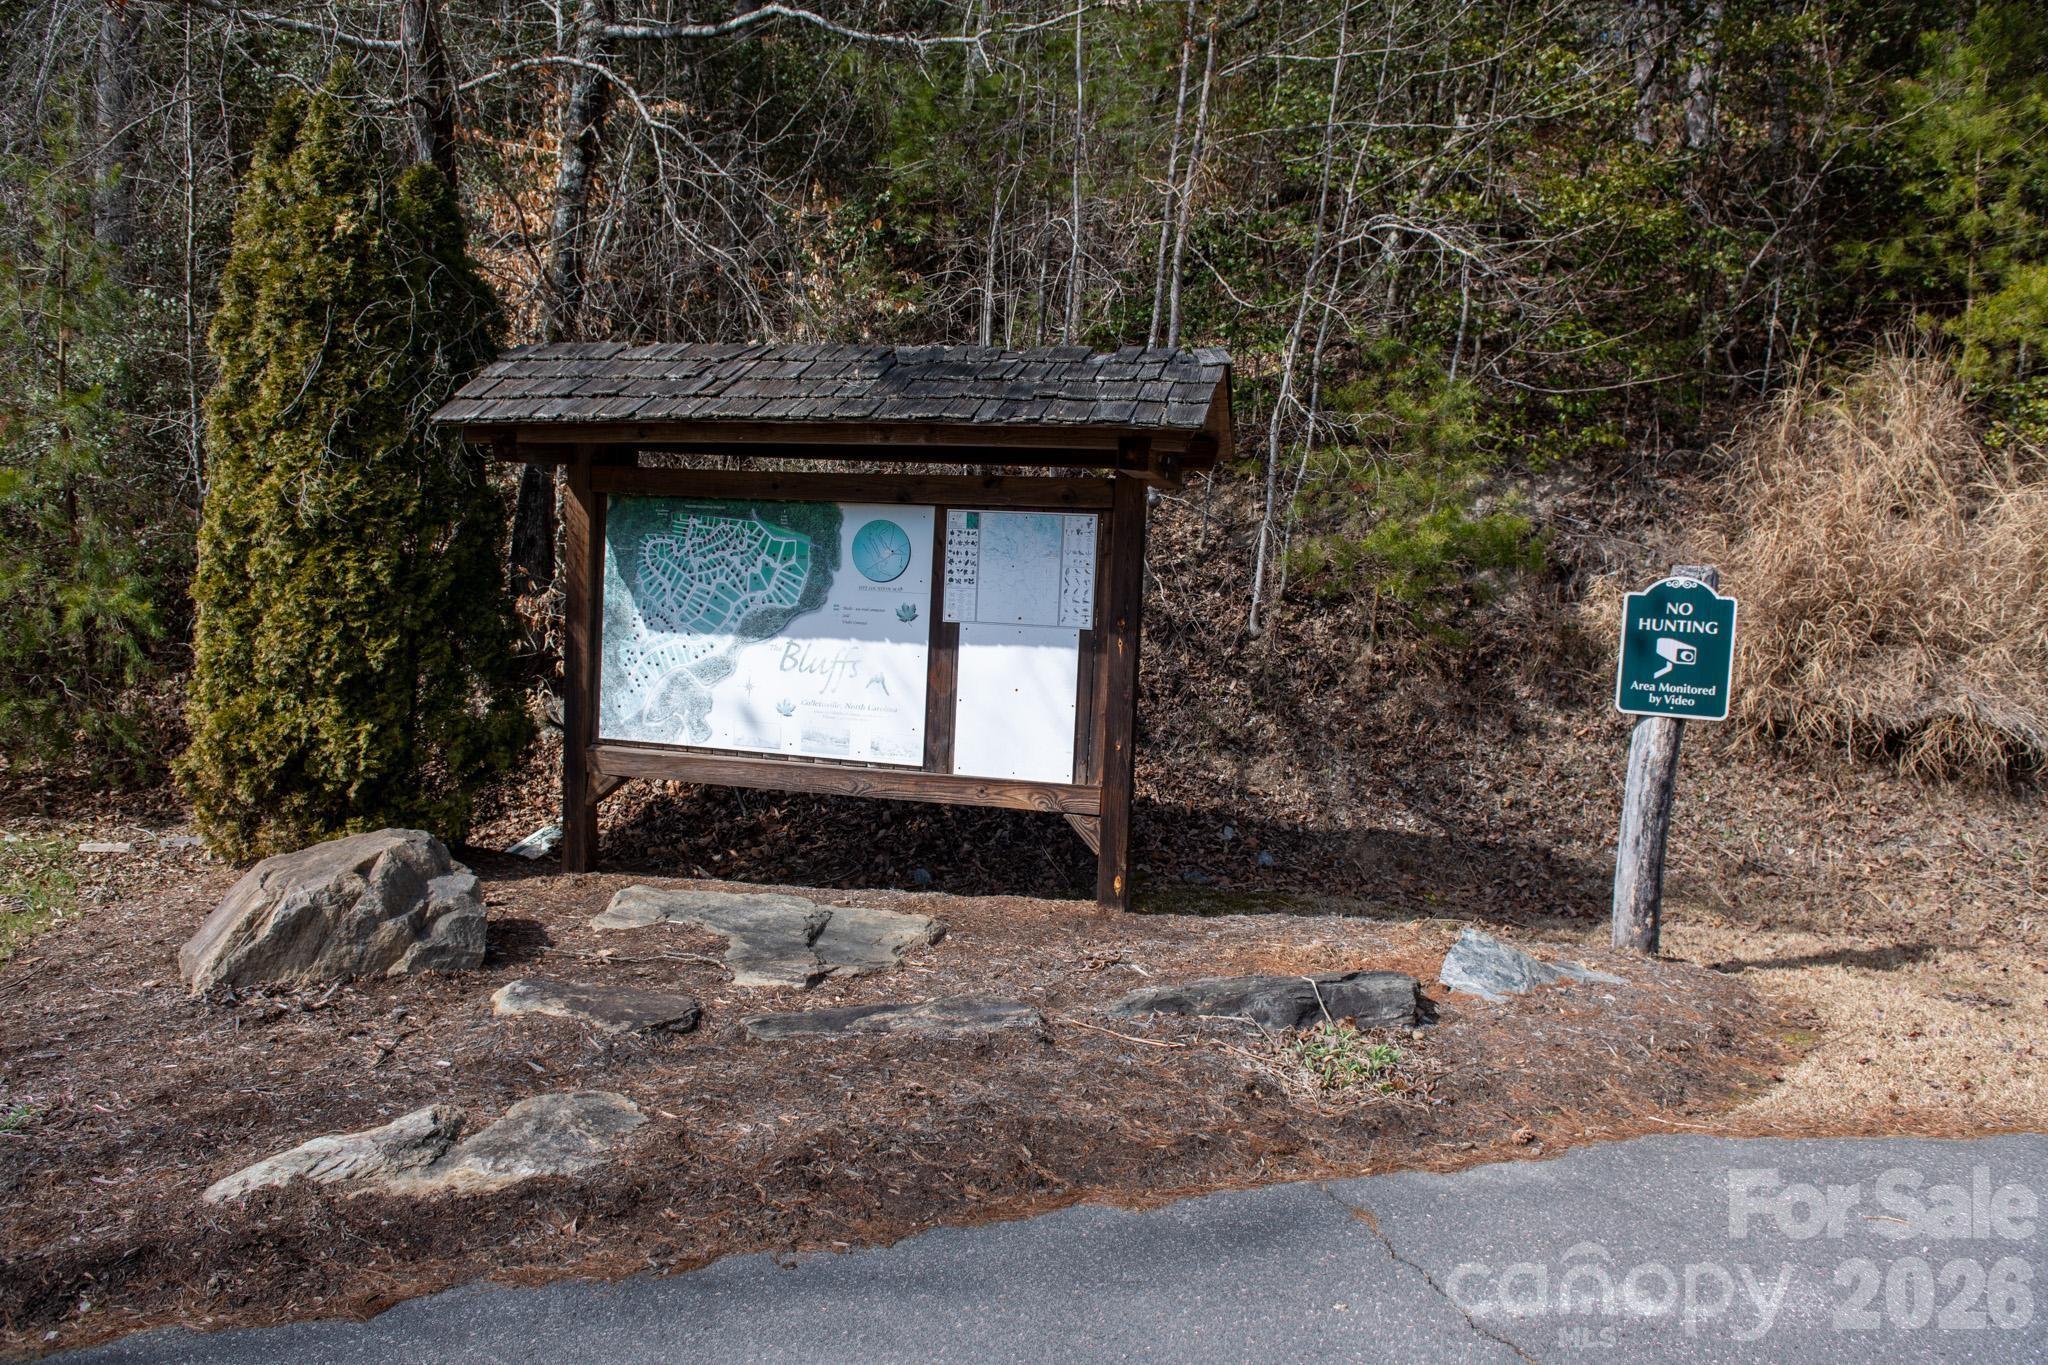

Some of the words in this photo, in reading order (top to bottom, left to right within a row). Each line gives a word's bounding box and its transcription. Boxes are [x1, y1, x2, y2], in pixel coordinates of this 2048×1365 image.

[1666, 602, 1694, 616] NO
[1638, 618, 1719, 634] HUNTING
[780, 639, 862, 695] Bluffs
[1630, 680, 1656, 692] Area
[1658, 682, 1716, 696] Monitored
[1648, 693, 1662, 706] by
[1664, 695, 1695, 706] Video
